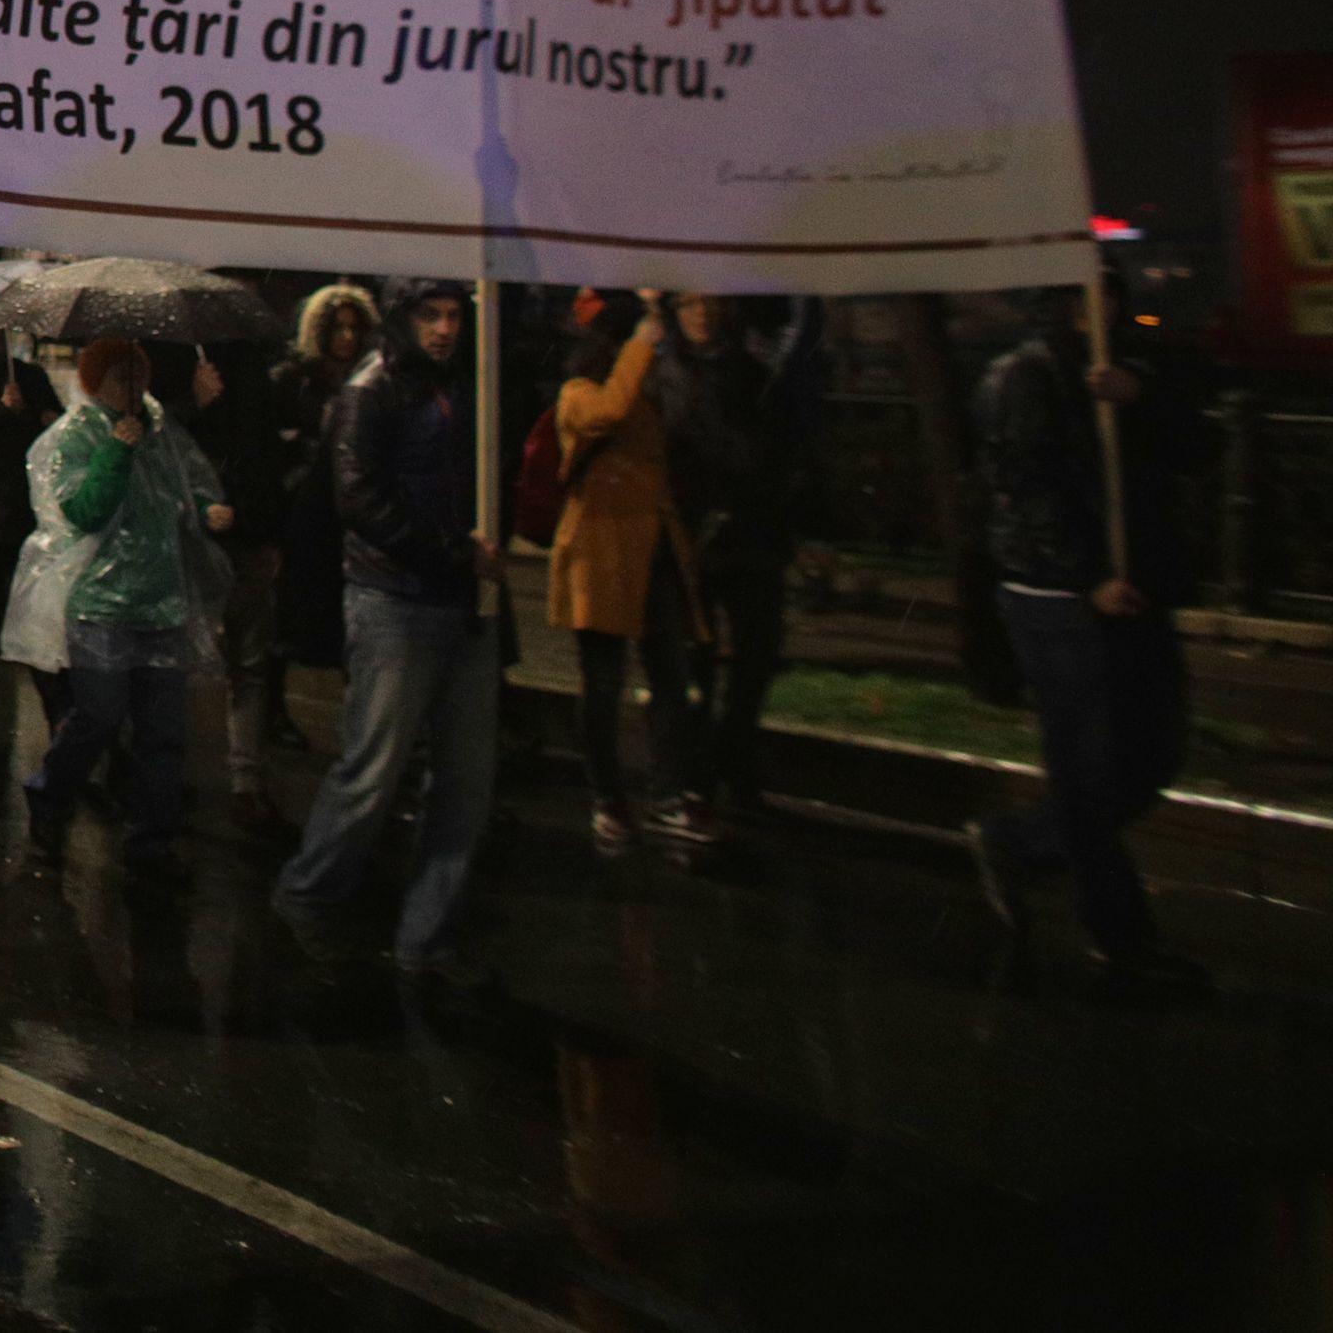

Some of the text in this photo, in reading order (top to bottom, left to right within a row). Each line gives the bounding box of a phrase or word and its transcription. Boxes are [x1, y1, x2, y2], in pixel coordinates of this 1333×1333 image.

[262, 1, 366, 67] din
[383, 8, 537, 85] jurul
[159, 86, 326, 156] 2018
